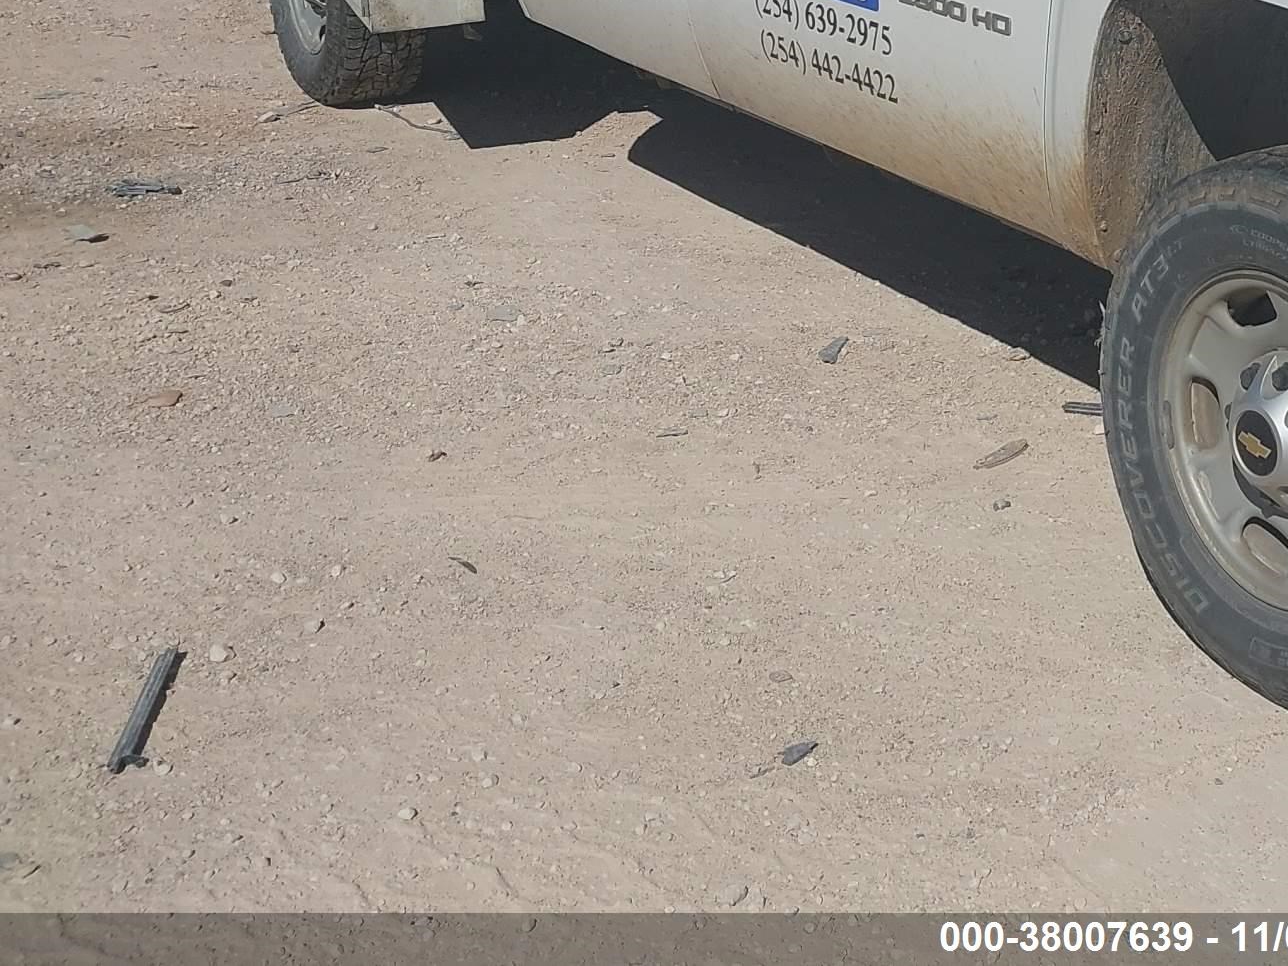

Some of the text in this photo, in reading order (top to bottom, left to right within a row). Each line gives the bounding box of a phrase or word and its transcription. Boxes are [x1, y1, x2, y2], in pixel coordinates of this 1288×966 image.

[805, 1, 893, 56] 639-2975
[972, 7, 1012, 37] HD
[760, 29, 899, 104] (254) 442-4422
[1131, 253, 1170, 323] AT3
[1116, 336, 1209, 614] DISCOVERER
